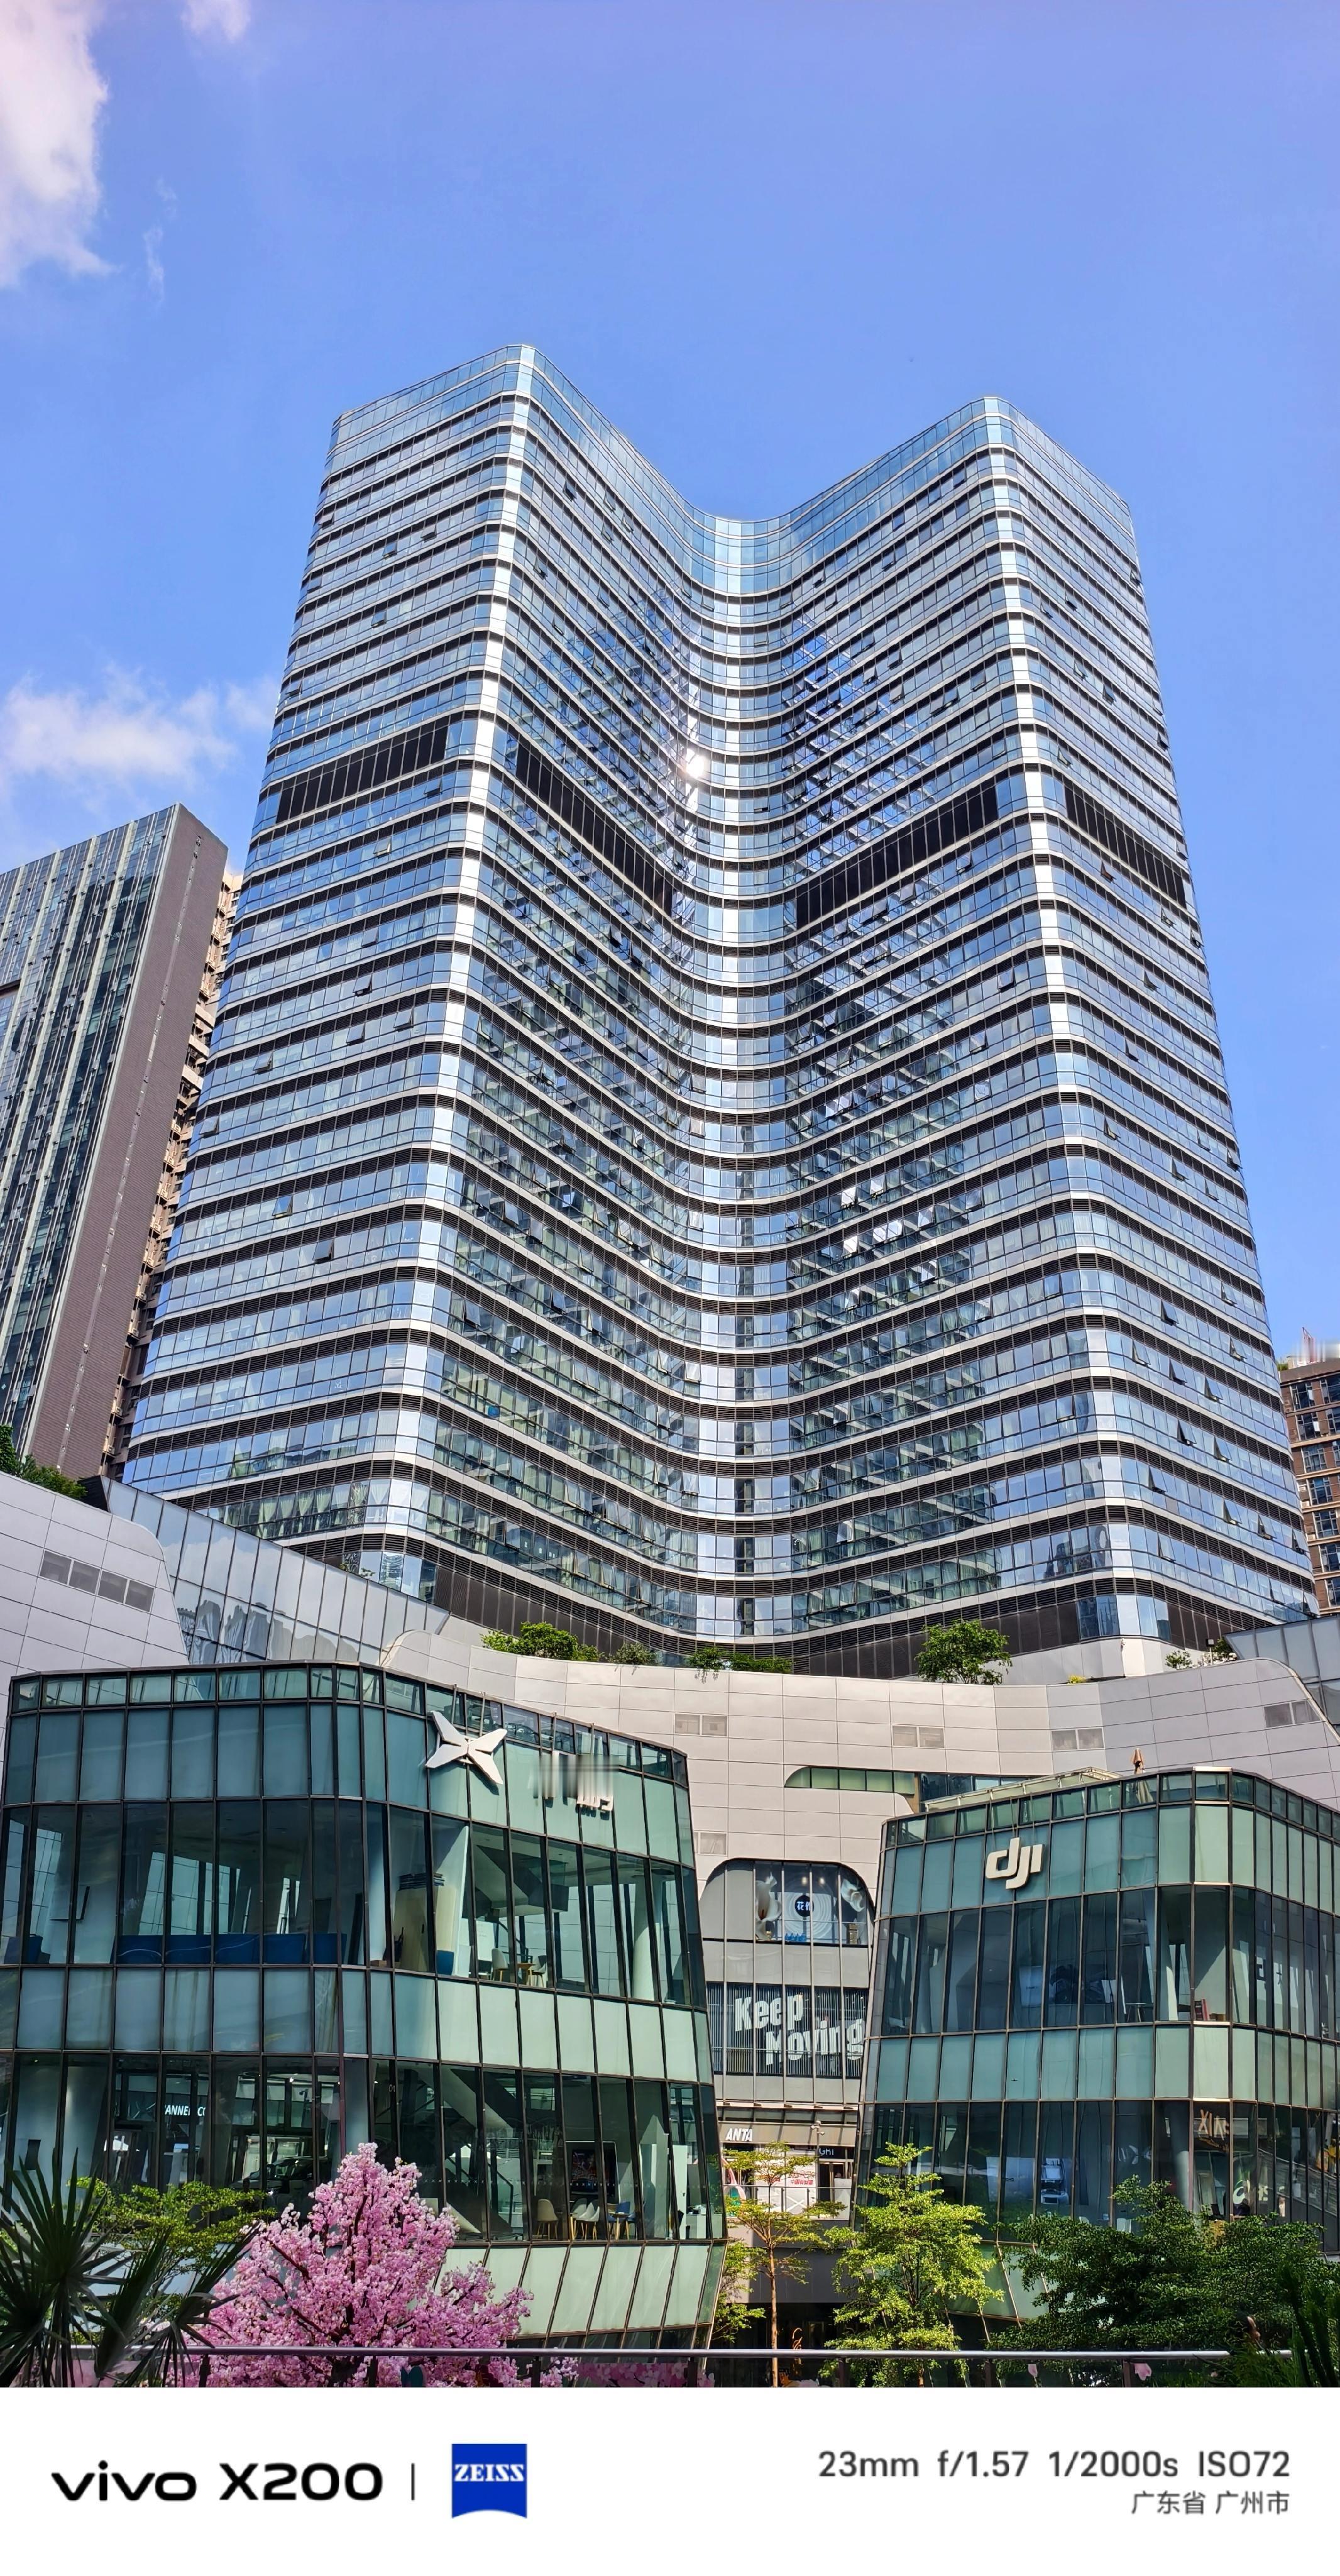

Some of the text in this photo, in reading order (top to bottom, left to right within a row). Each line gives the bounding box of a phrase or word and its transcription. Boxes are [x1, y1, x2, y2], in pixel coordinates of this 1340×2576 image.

[735, 1994, 803, 2032] Keep
[766, 2018, 864, 2066] Moving
[724, 2128, 752, 2142] ANTA
